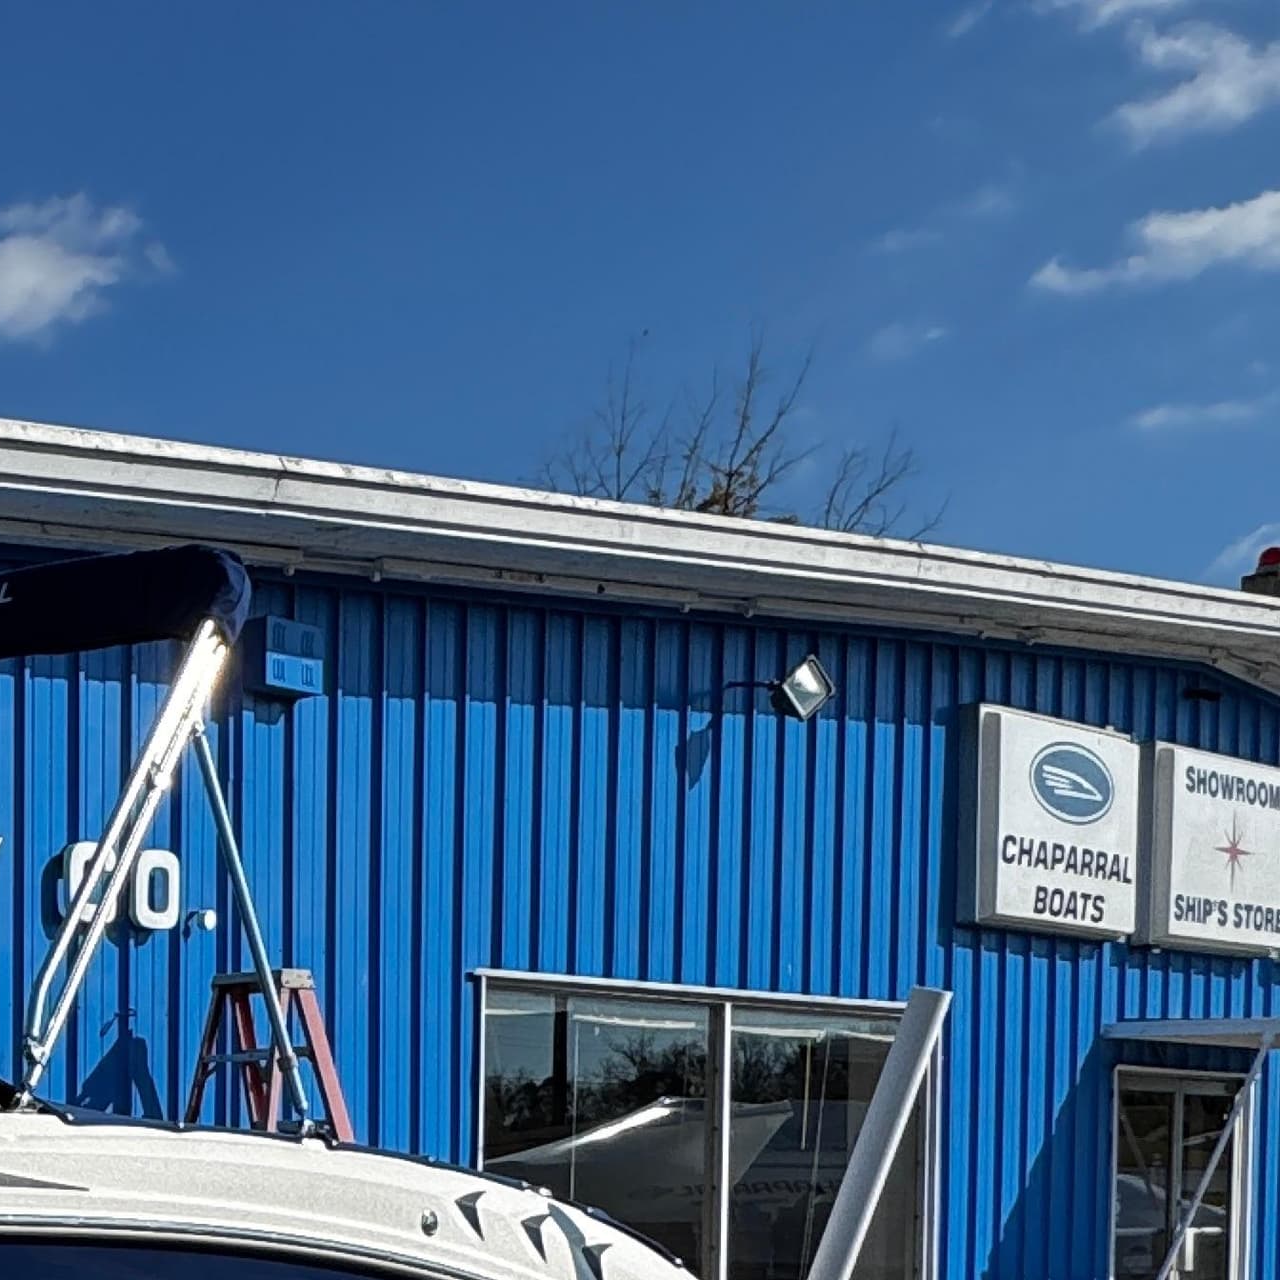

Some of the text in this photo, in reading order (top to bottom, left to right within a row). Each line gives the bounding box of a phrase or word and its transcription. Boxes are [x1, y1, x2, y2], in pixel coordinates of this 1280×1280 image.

[1185, 765, 1280, 811] SHOWROOM
[1001, 834, 1133, 885] CHAPARRAL
[1032, 884, 1106, 924] BOATS
[1174, 893, 1228, 927] SHIP'S
